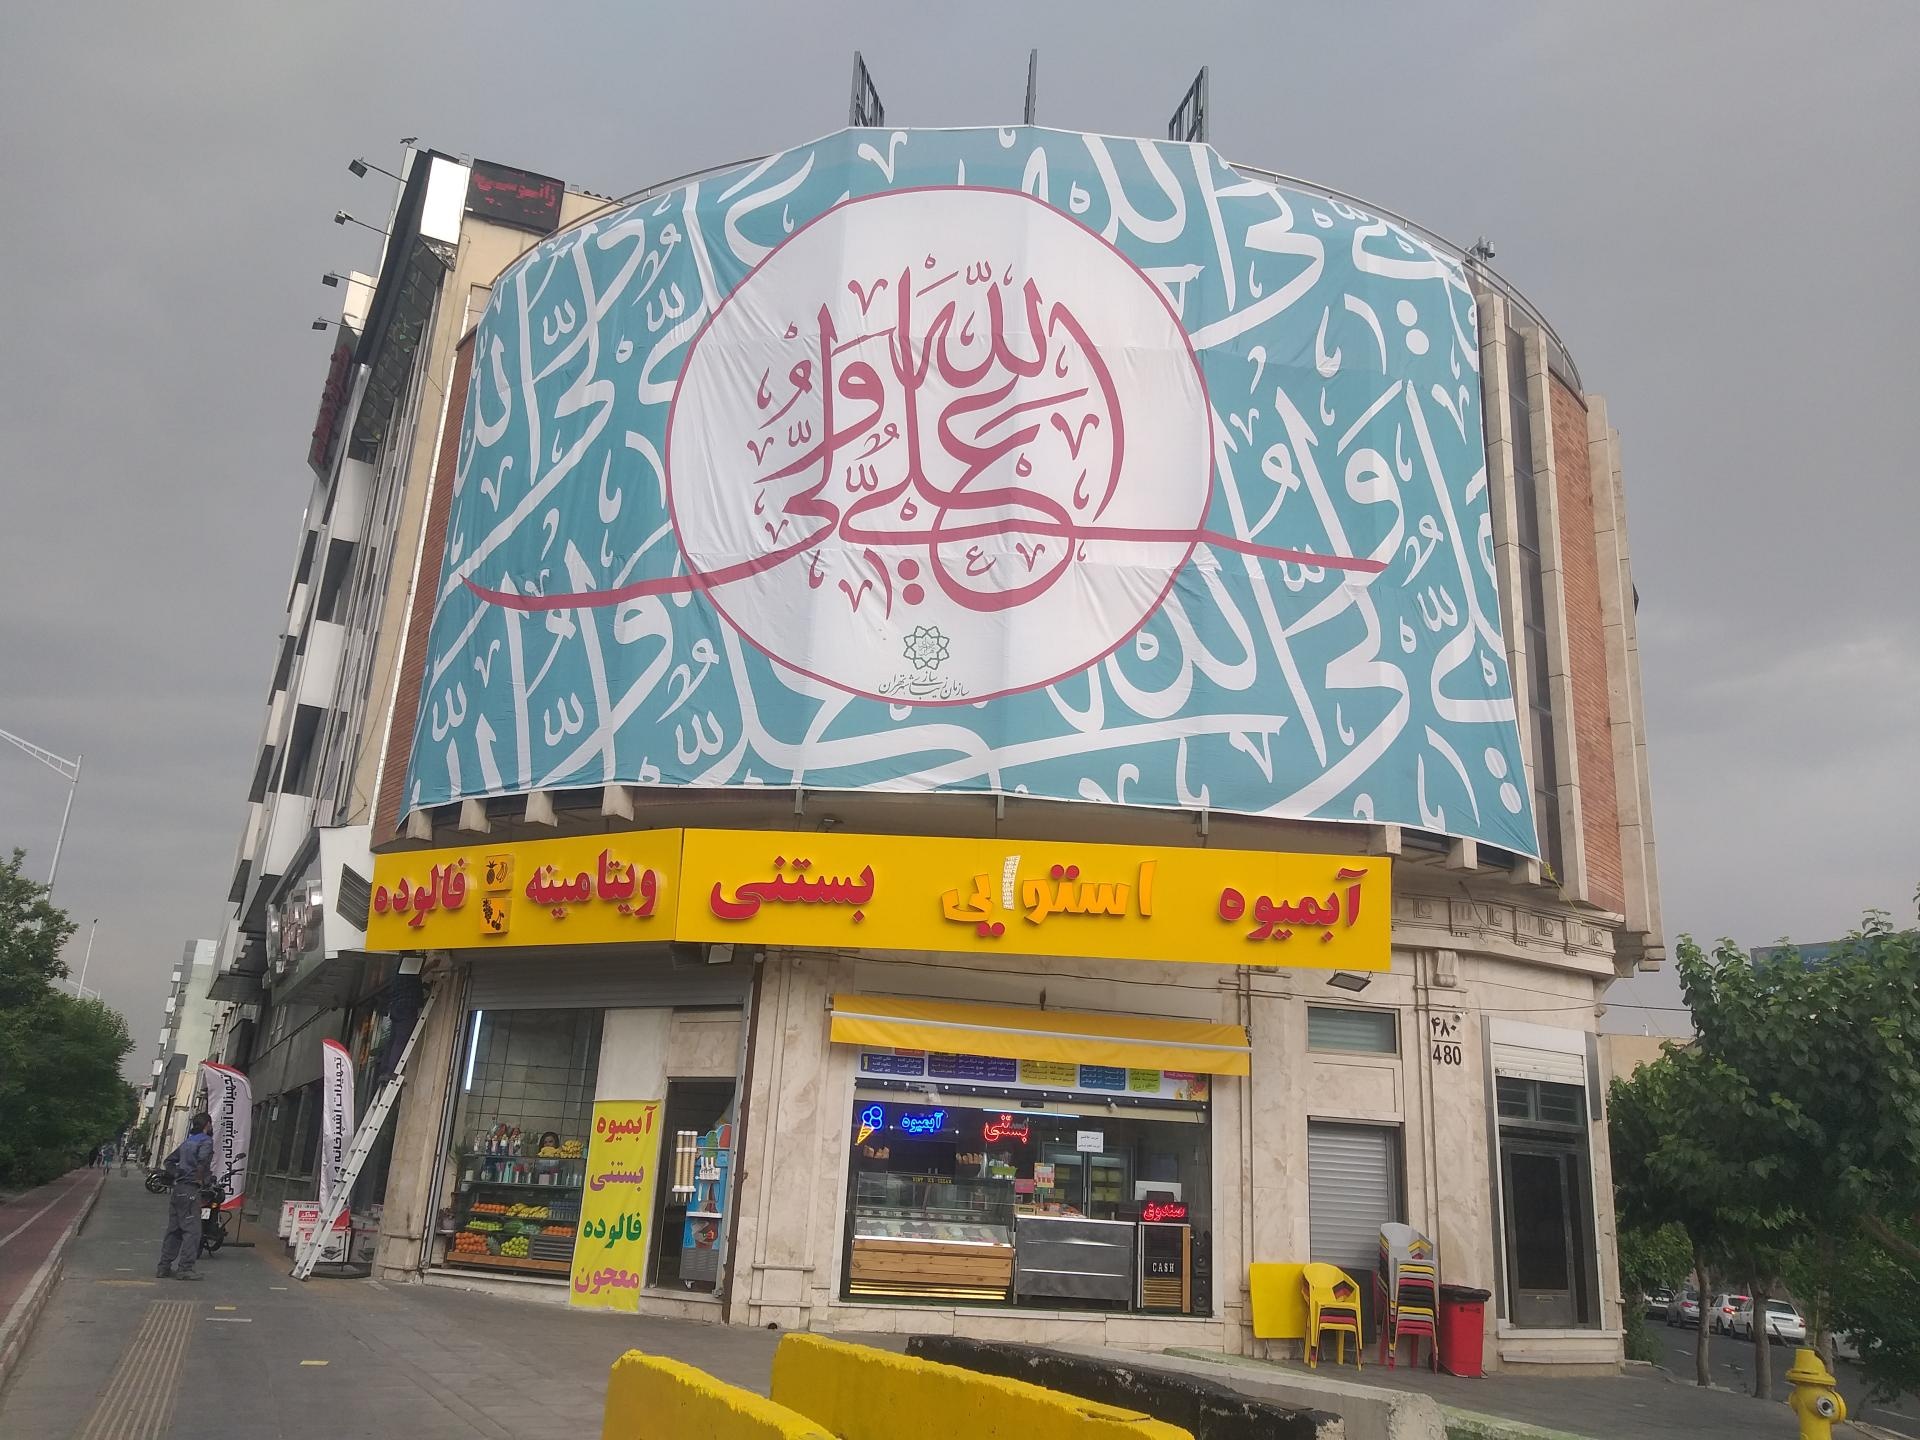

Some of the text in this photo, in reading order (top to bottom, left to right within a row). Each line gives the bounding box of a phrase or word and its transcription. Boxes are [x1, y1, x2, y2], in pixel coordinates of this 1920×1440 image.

[940, 680, 970, 699] سازمان
[373, 848, 1369, 943] آبمیوه استوایی بستنی ویتامینه فالوده
[1431, 1017, 1457, 1037] ۴۸۰
[1433, 1044, 1461, 1065] 480
[596, 1106, 658, 1143] آبمیوه
[901, 1110, 944, 1133] آبمیوه
[985, 1114, 1030, 1143] بستنی
[589, 1161, 645, 1192] بستنی
[1144, 1202, 1185, 1221] صندوق
[583, 1212, 642, 1249] فالوده
[1152, 1262, 1175, 1273] CASH
[574, 1266, 640, 1296] معجون
